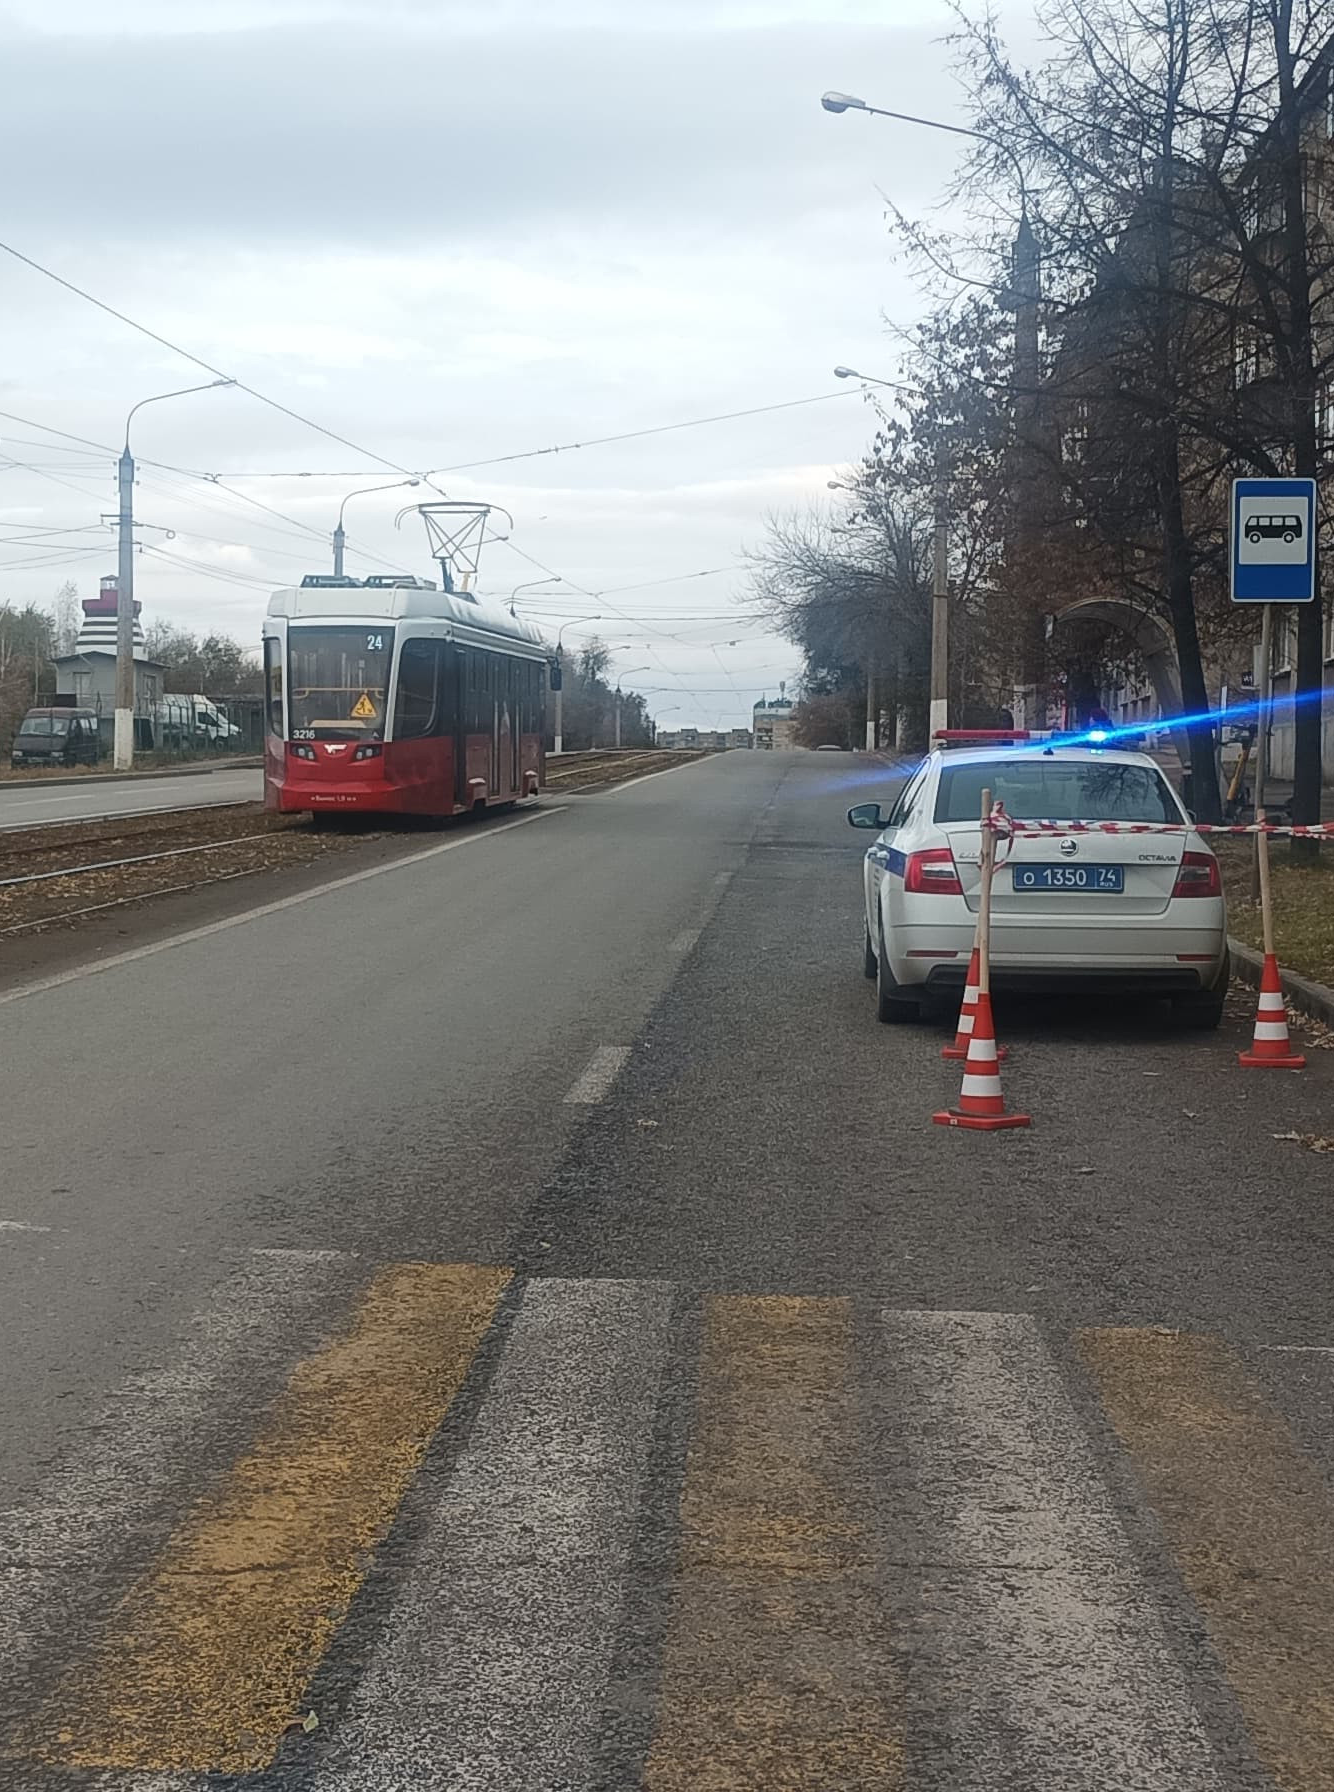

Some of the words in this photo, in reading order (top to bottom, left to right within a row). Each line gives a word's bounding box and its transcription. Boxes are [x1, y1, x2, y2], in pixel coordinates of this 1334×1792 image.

[367, 635, 383, 650] 24
[1138, 854, 1176, 862] OCTAVIA
[1043, 869, 1087, 886] 1350
[1098, 869, 1116, 882] 74
